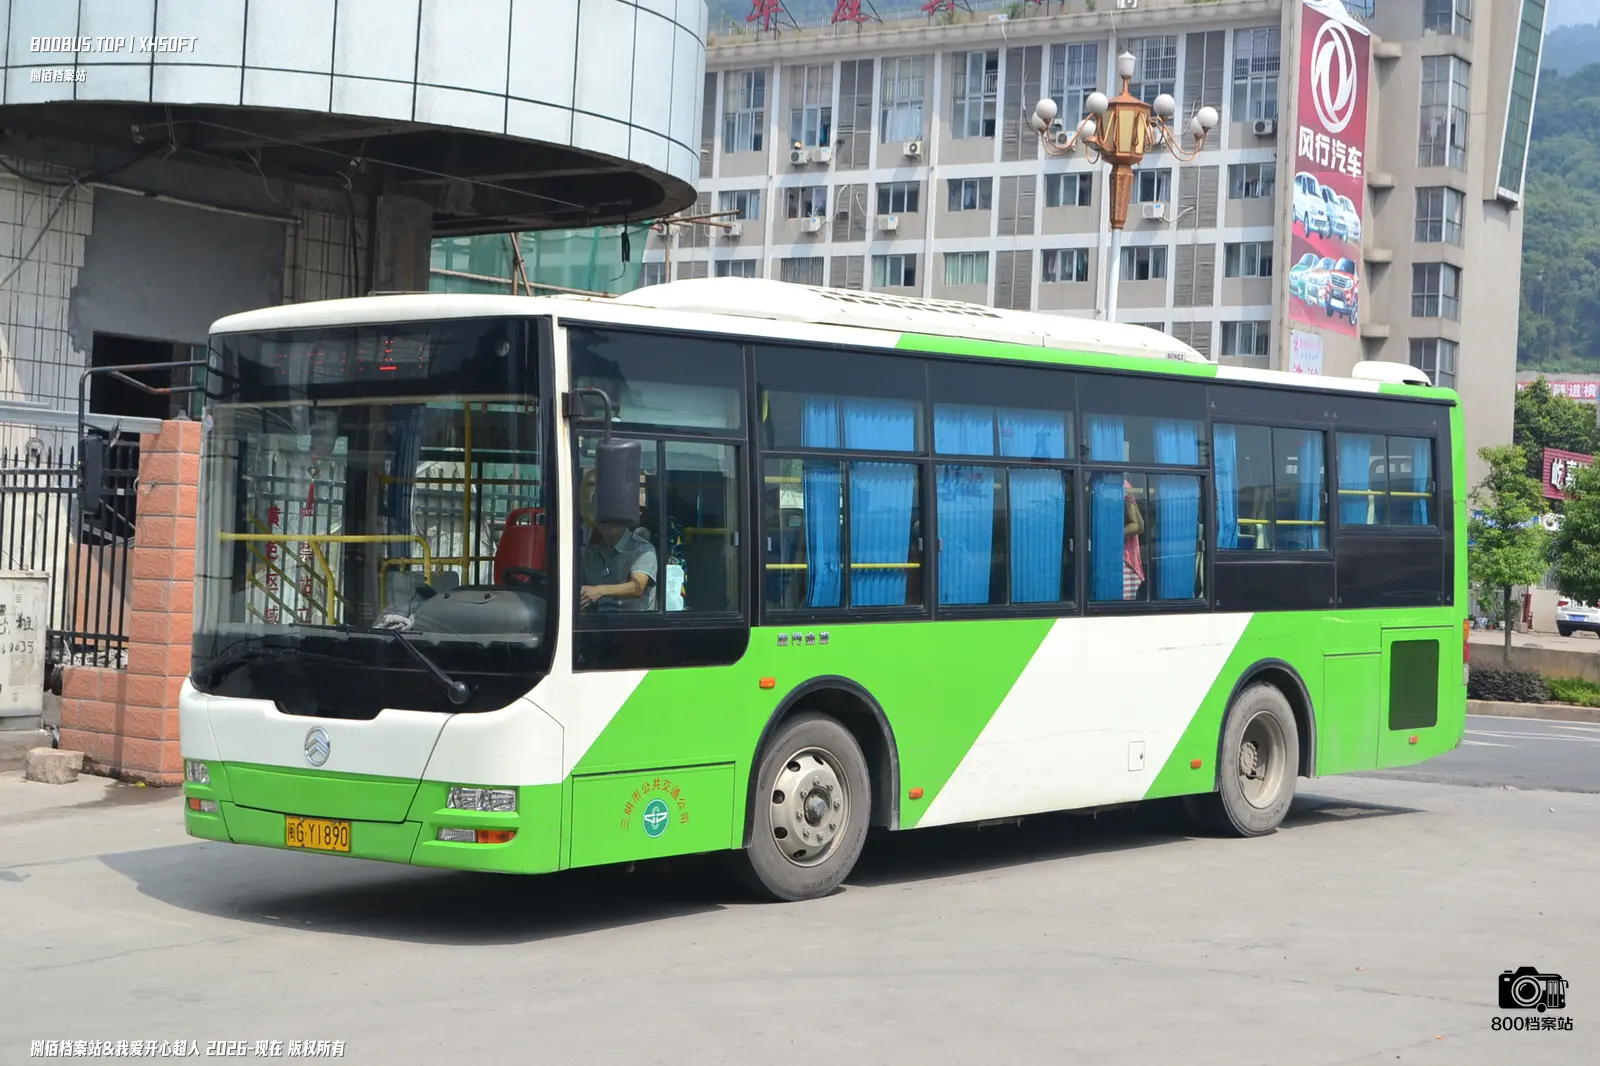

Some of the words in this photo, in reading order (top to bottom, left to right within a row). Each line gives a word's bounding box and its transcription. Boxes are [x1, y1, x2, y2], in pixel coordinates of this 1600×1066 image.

[1298, 125, 1363, 178] 风行汽车
[620, 777, 690, 831] 三明市公共交通公司
